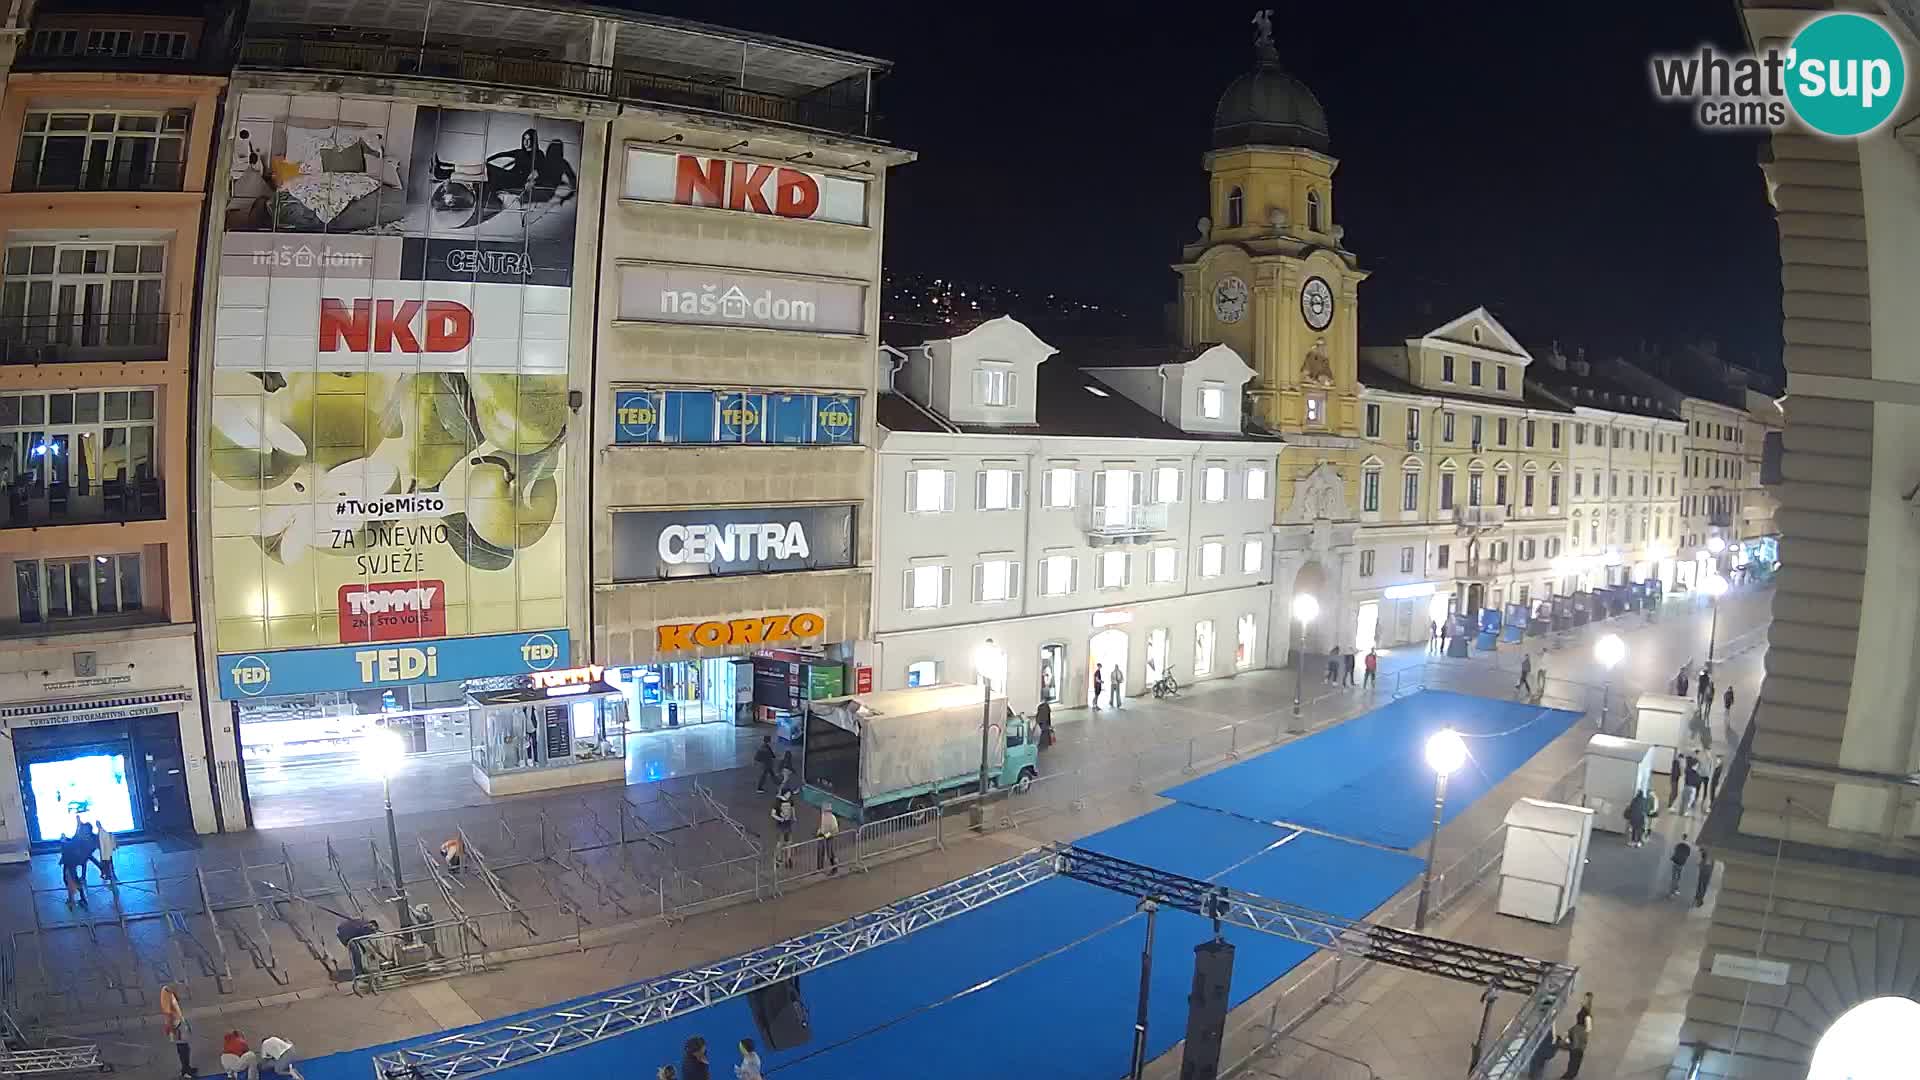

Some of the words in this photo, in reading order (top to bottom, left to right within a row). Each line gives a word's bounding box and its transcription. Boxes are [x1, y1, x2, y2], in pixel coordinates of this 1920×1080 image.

[674, 154, 820, 220] NKD
[252, 244, 292, 267] naš
[316, 246, 363, 267] dom
[446, 249, 533, 276] CENTRA
[661, 284, 717, 315] naš
[753, 290, 816, 323] dom
[318, 297, 474, 354] NKD
[618, 408, 656, 425] TEDi
[722, 409, 758, 425] TEDi
[819, 411, 852, 426] TEDi
[336, 497, 444, 517] #TvojeMisto
[331, 529, 355, 549] ZA
[366, 524, 449, 549] DNEVNO
[658, 521, 809, 564] CENTRA
[357, 548, 424, 575] SVJEŽE
[346, 587, 437, 614] TOMMY
[657, 612, 825, 651] KORZO
[355, 647, 437, 683] TEDi
[520, 643, 559, 661] TEDi
[231, 666, 271, 686] TEDi
[530, 664, 604, 689] TOMMY
